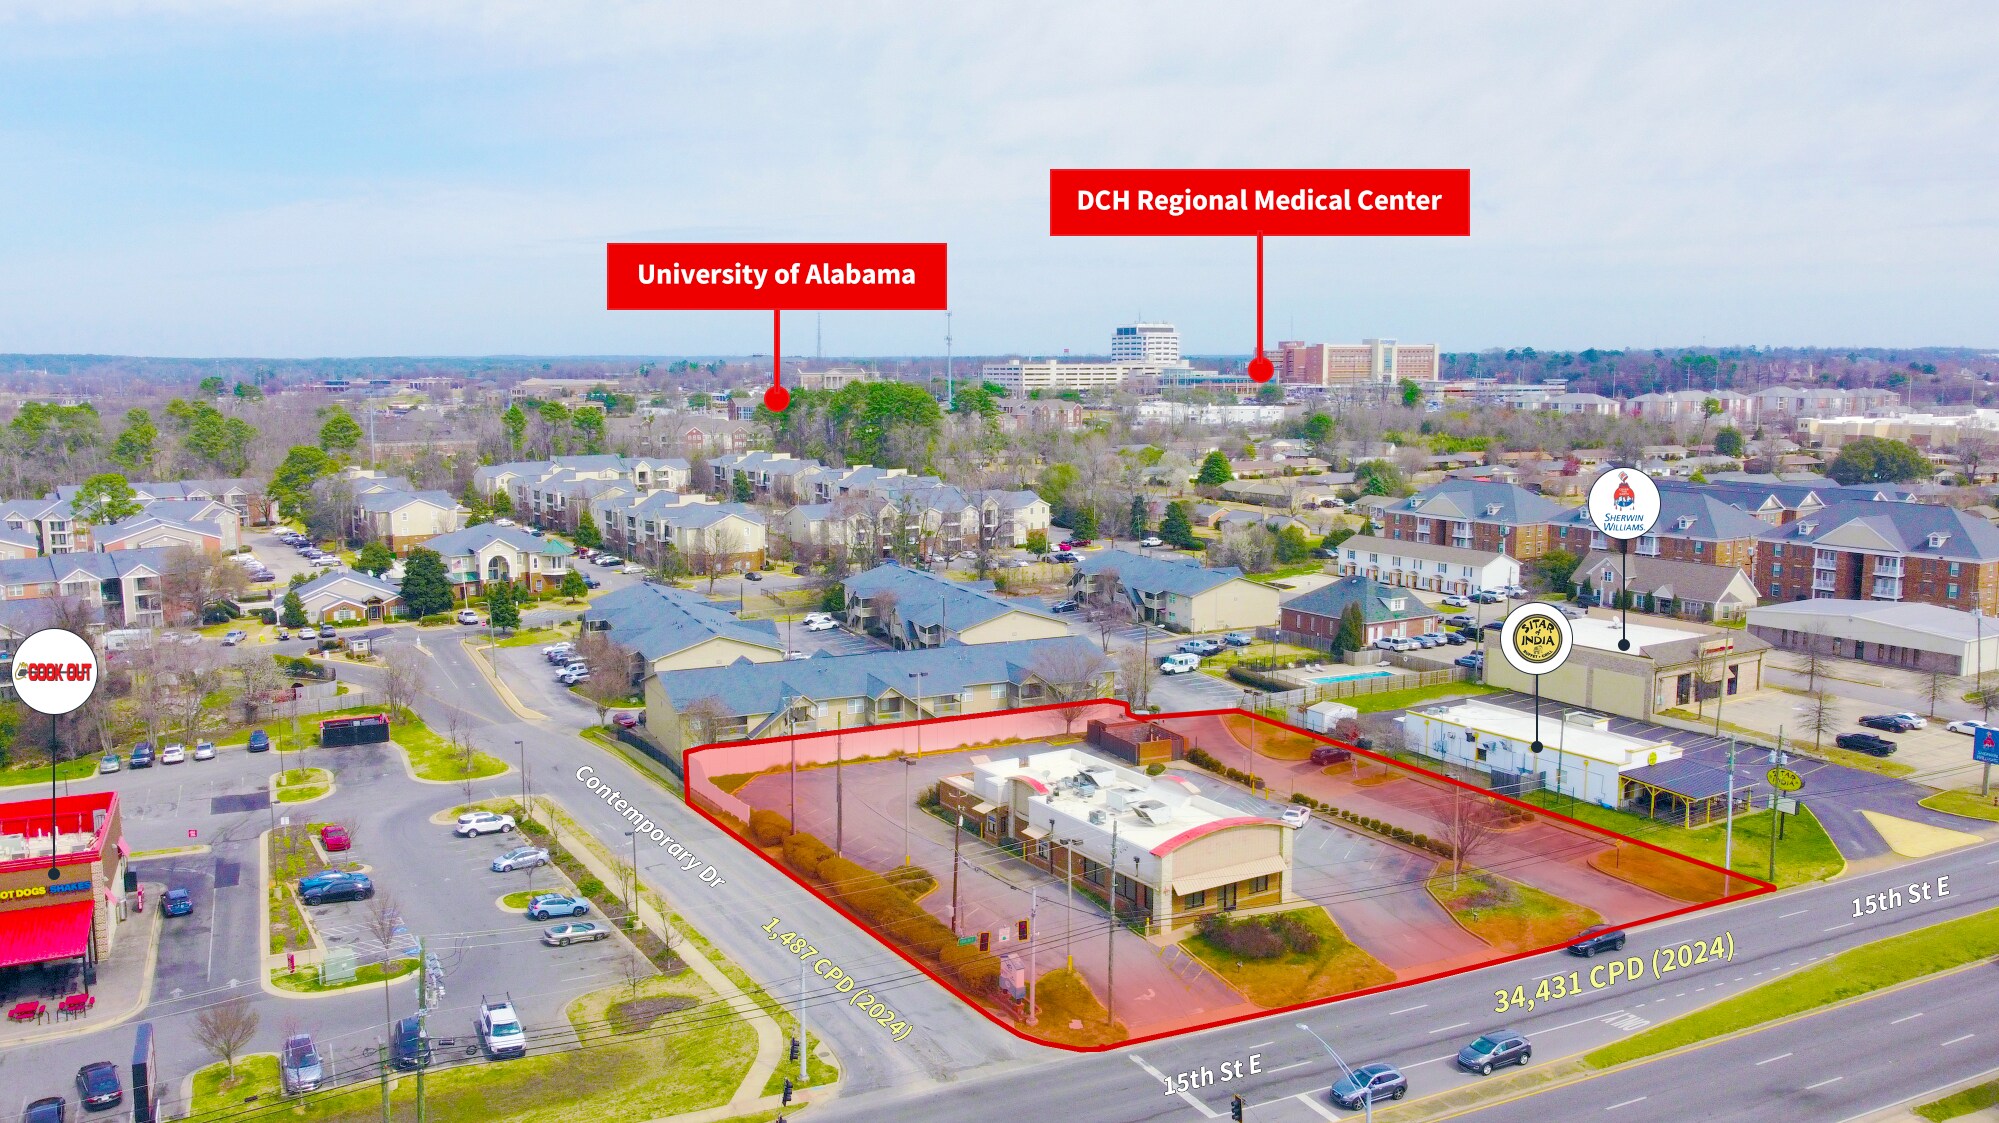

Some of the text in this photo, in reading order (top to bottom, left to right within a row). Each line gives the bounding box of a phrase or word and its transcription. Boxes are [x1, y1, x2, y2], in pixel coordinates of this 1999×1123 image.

[1772, 770, 1796, 780] STAR
[0, 881, 92, 900] OT DOGS SHAKES
